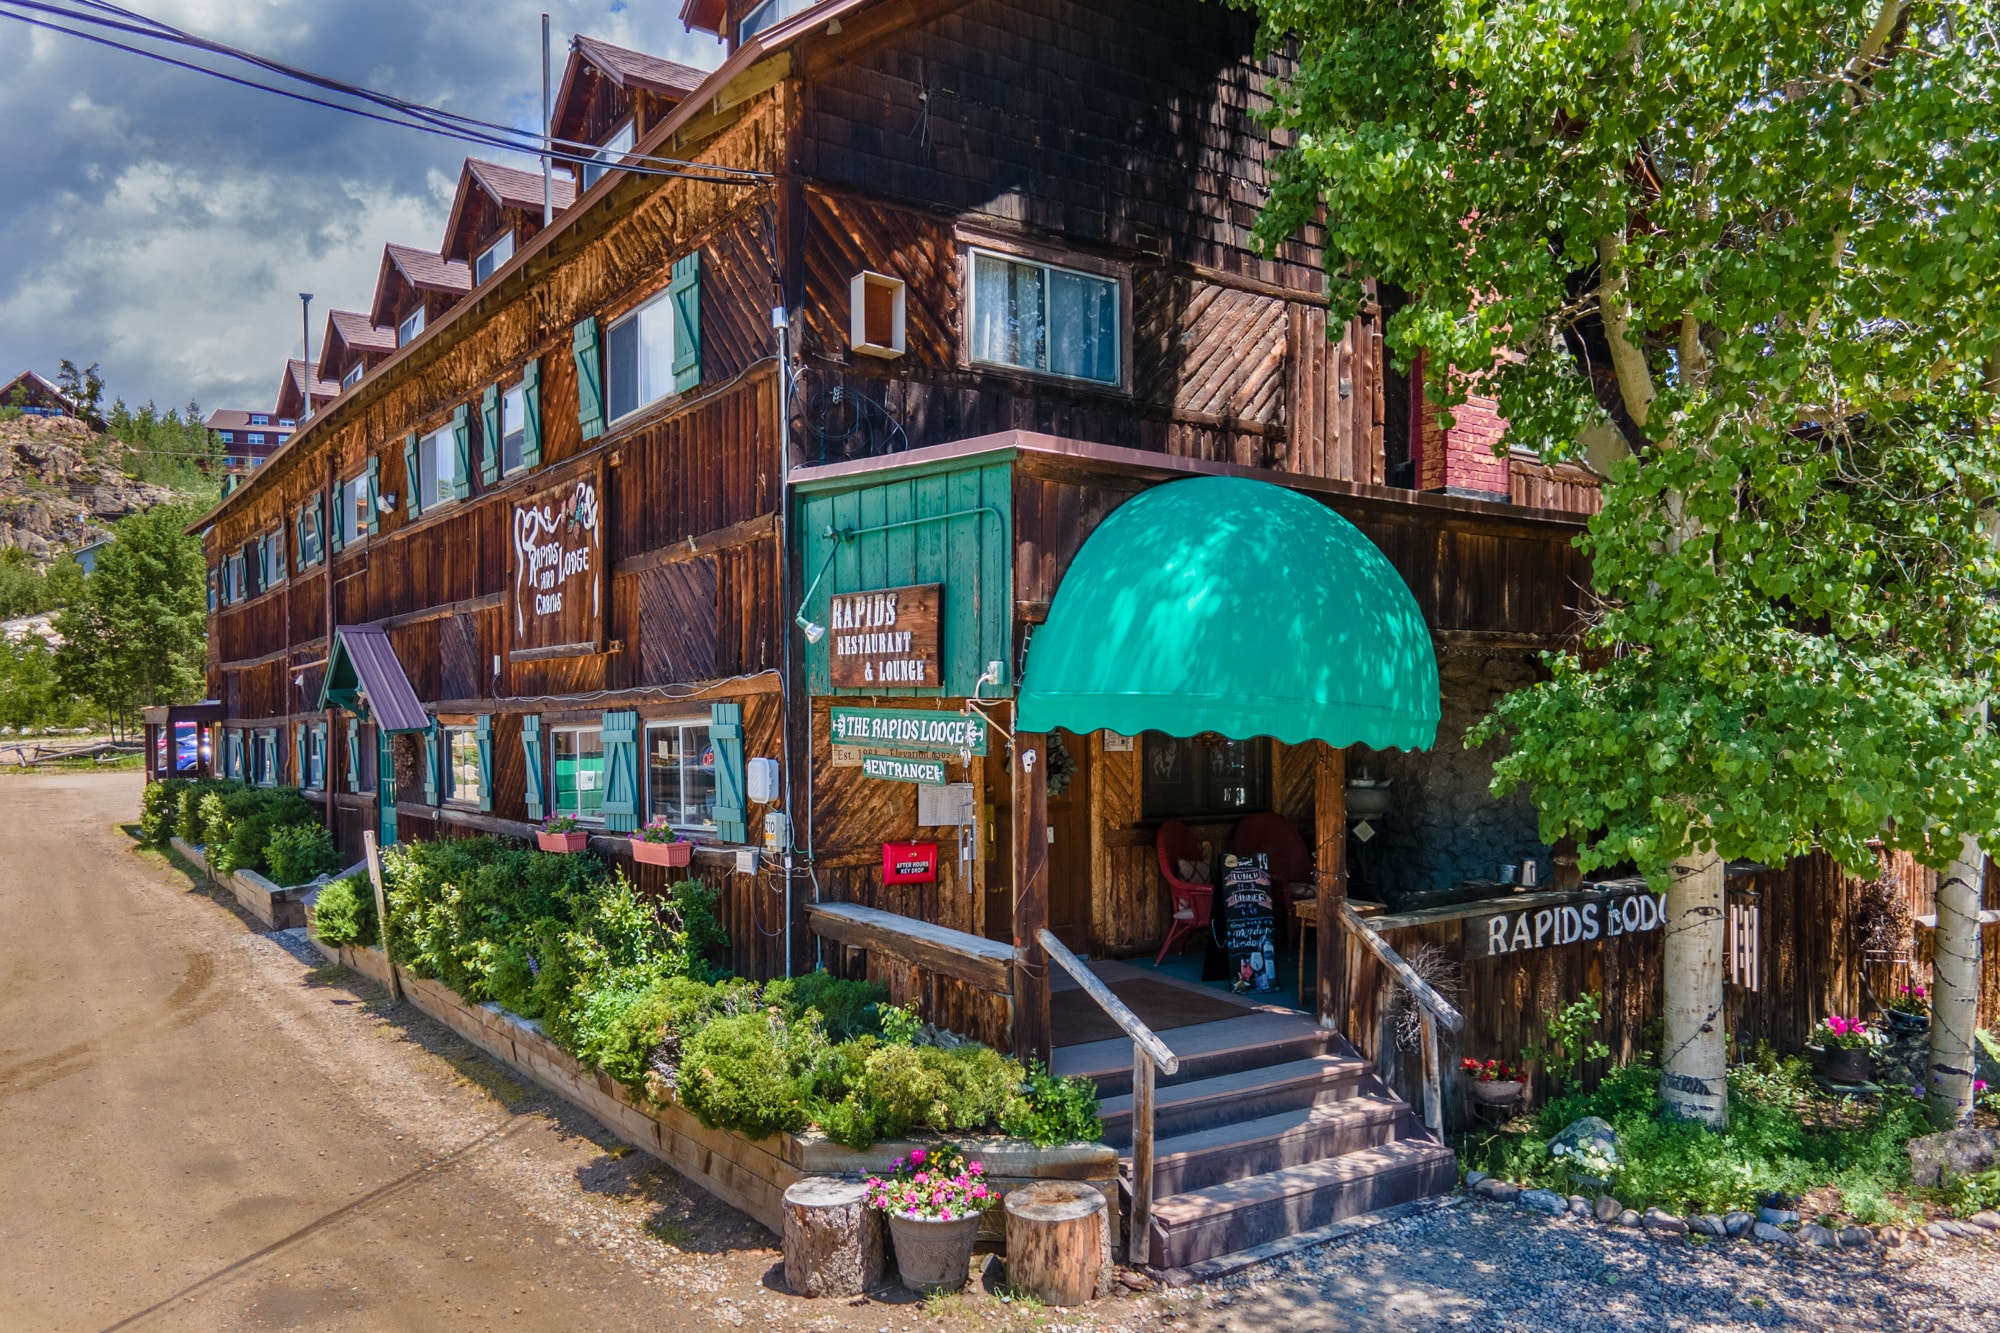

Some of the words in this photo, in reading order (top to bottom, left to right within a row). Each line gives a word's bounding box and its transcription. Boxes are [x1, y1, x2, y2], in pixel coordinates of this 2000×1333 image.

[529, 542, 560, 587] RAPIDS
[558, 546, 589, 585] LODGE
[535, 593, 562, 616] CABINS
[832, 593, 897, 629] RAPIDS
[837, 632, 911, 655] RESTAURANT
[864, 661, 873, 681] &
[879, 660, 925, 681] LOUNGE
[847, 716, 870, 737] THE
[872, 718, 919, 740] RAPIDS
[920, 720, 965, 745] LODGE
[702, 752, 714, 766] OP
[838, 749, 854, 761] Est.
[871, 759, 936, 781] ENTRANCE
[1233, 872, 1259, 880] LUNCH
[1234, 893, 1266, 902] DINNER
[1487, 903, 1600, 956] RAPIDS
[1607, 893, 1667, 937] LOD
